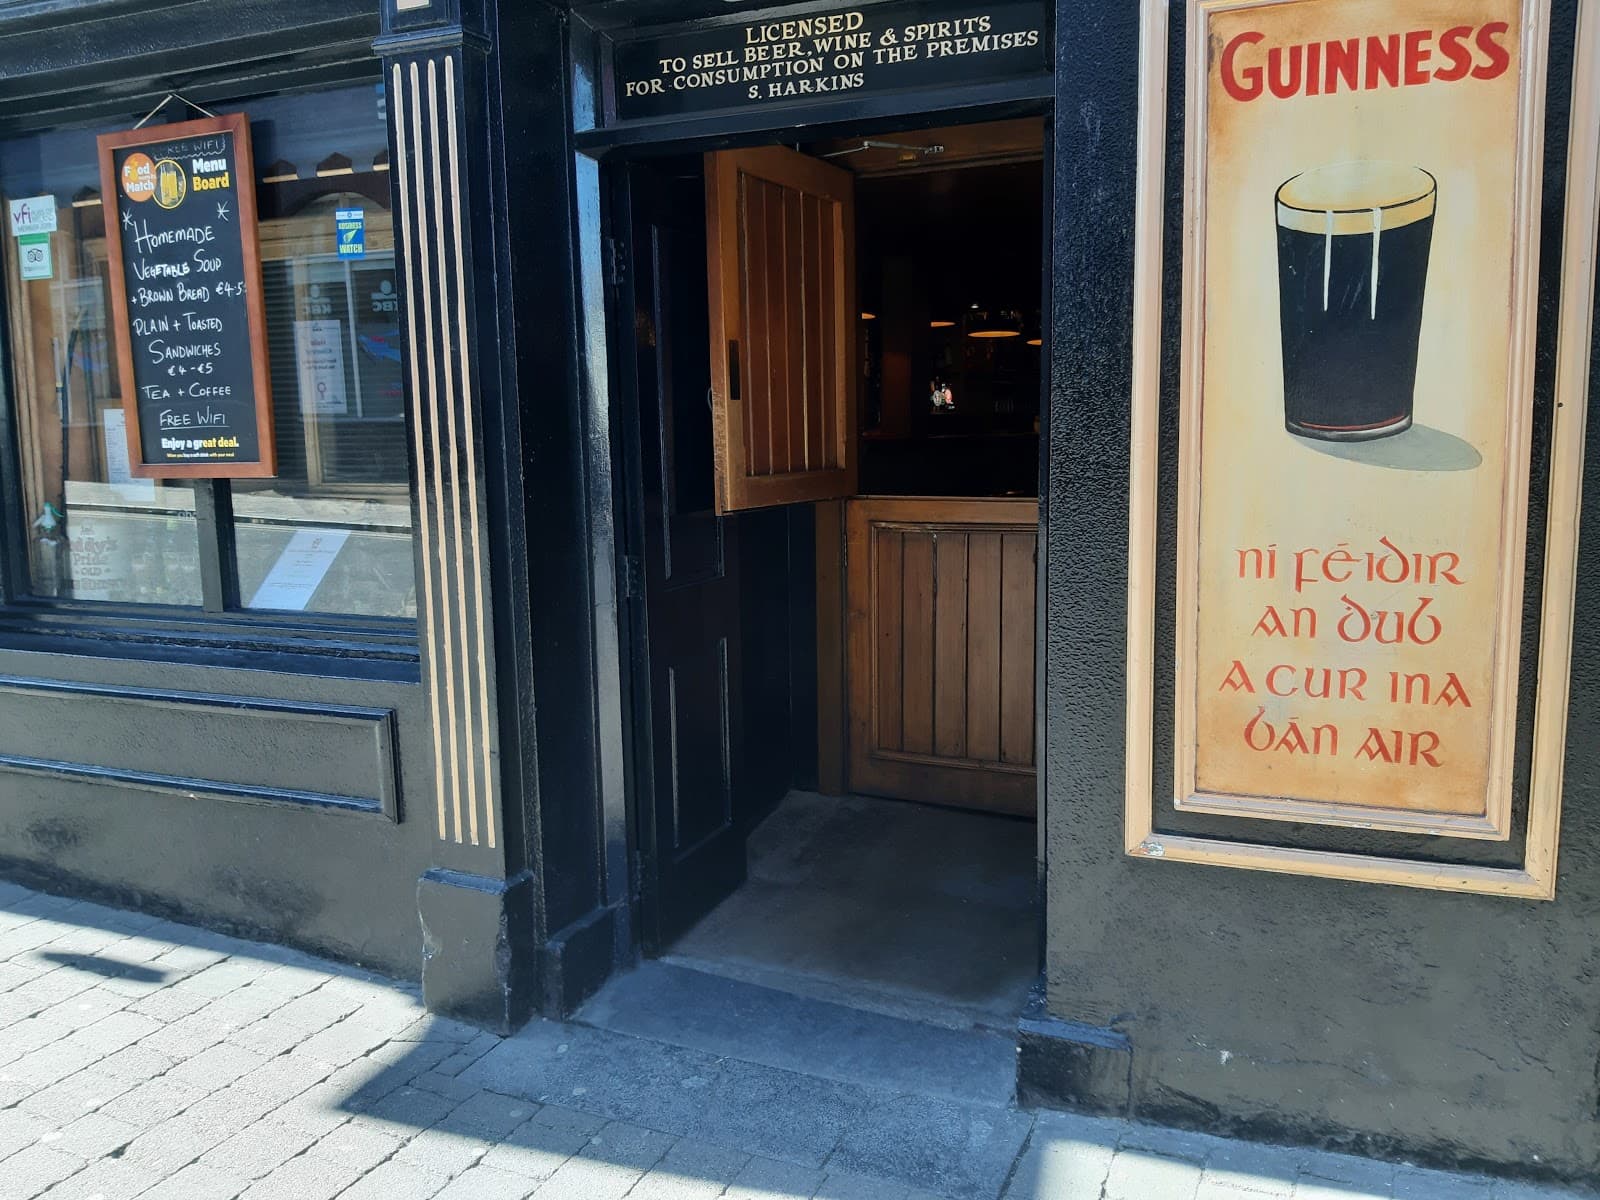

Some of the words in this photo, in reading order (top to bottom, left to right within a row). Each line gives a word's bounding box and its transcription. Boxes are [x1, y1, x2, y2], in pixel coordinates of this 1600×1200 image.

[746, 11, 864, 45] LICENSED
[659, 57, 687, 74] TO
[692, 51, 740, 69] SELL
[879, 28, 897, 46] &
[904, 16, 992, 43] SPIRITS
[625, 78, 666, 97] FOR
[673, 57, 824, 90] CONSUMPTION
[833, 51, 865, 70] ON
[872, 45, 919, 65] THE
[926, 30, 1039, 59] PREMISES
[1220, 21, 1510, 102] GUINNESS
[748, 85, 762, 99] S.
[768, 72, 865, 98] HARKINS
[192, 158, 227, 174] Menu
[126, 180, 155, 192] Match
[192, 172, 230, 191] Board
[13, 203, 32, 225] vfi
[172, 320, 181, 331] +
[177, 388, 185, 397] +
[161, 437, 185, 450] Enjoy
[186, 439, 193, 448] a
[193, 437, 217, 450] great
[218, 436, 240, 448] deal.
